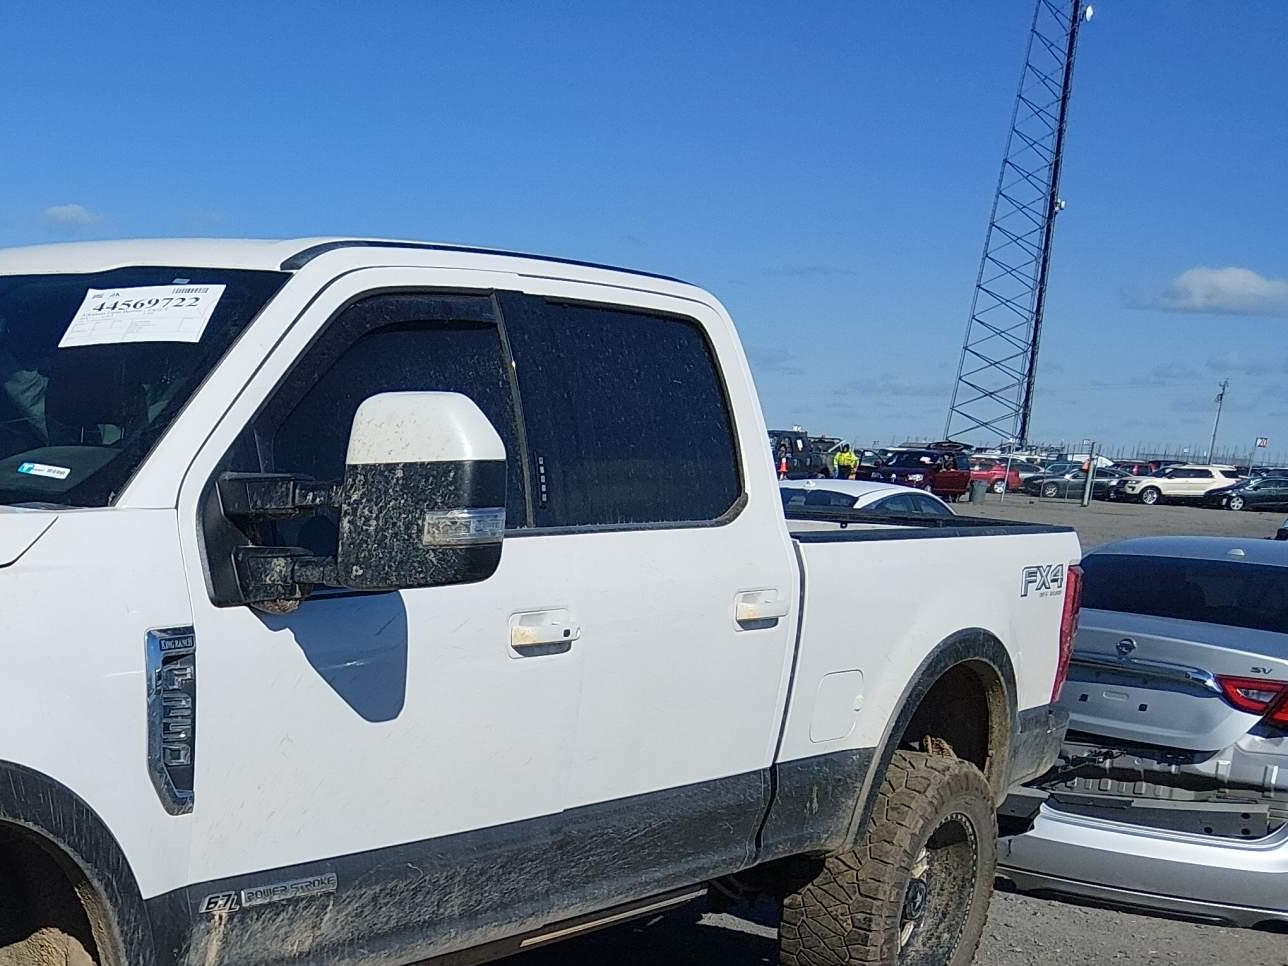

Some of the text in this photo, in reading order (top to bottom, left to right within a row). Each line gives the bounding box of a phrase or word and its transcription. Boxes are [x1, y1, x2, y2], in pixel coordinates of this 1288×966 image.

[93, 297, 200, 312] 44569722
[1021, 563, 1064, 597] FX4
[1250, 666, 1272, 675] SV
[246, 884, 288, 901] POWER
[290, 875, 336, 897] STROKE
